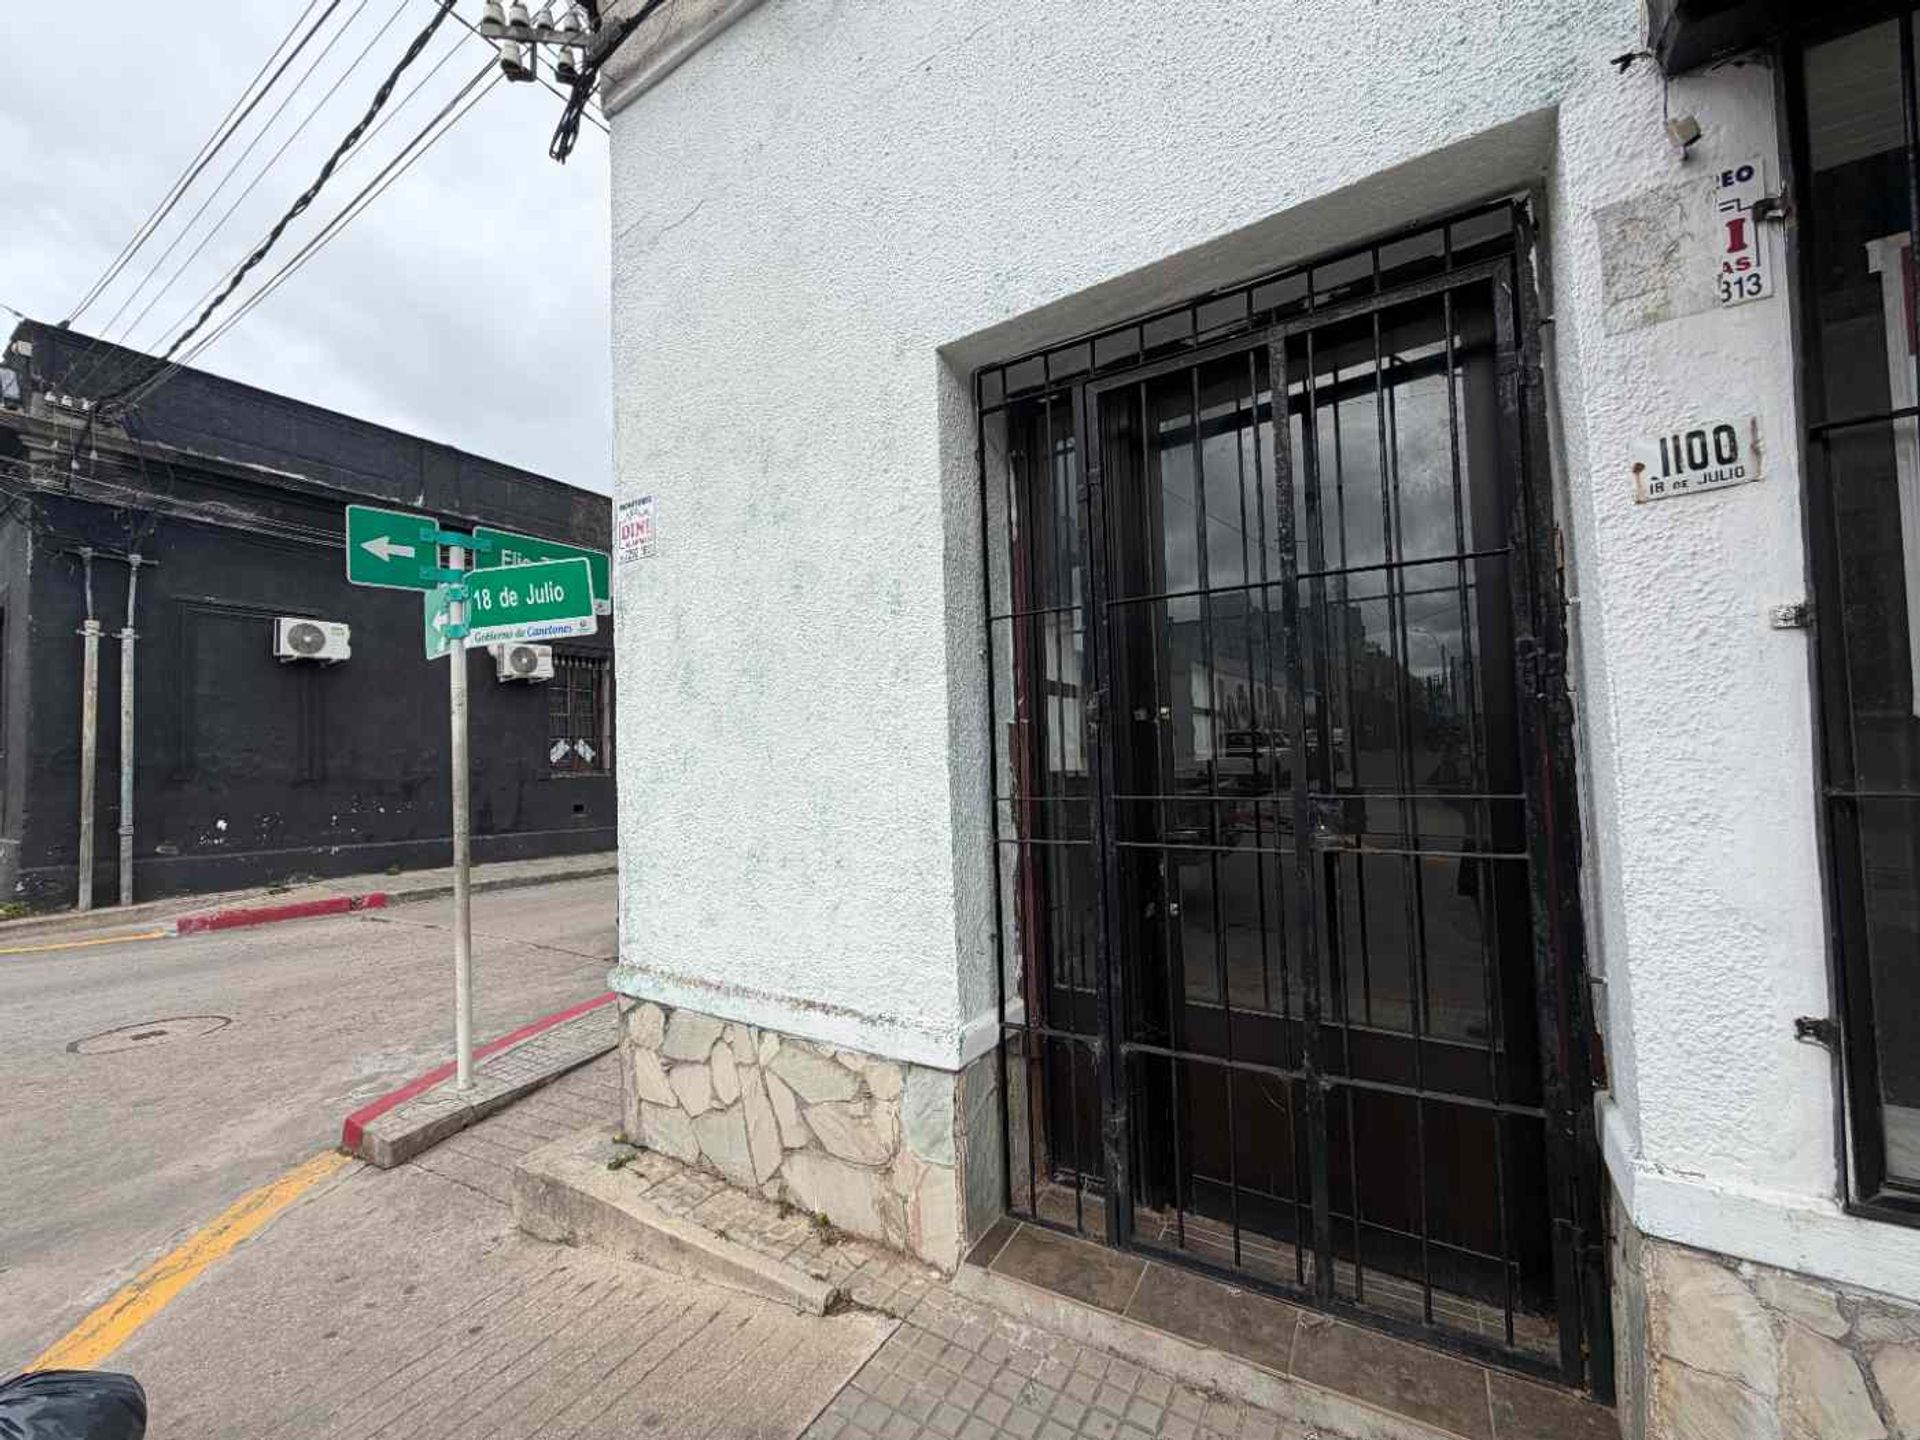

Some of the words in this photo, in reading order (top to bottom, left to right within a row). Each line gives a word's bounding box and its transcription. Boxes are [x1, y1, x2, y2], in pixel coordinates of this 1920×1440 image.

[1716, 165, 1754, 188] EO
[1659, 424, 1739, 478] 1100
[1697, 465, 1746, 485] JULIO
[472, 589, 493, 610] 18
[499, 587, 519, 606] de
[526, 581, 565, 605] Julio
[474, 629, 513, 642] Gobierno
[515, 628, 526, 638] de
